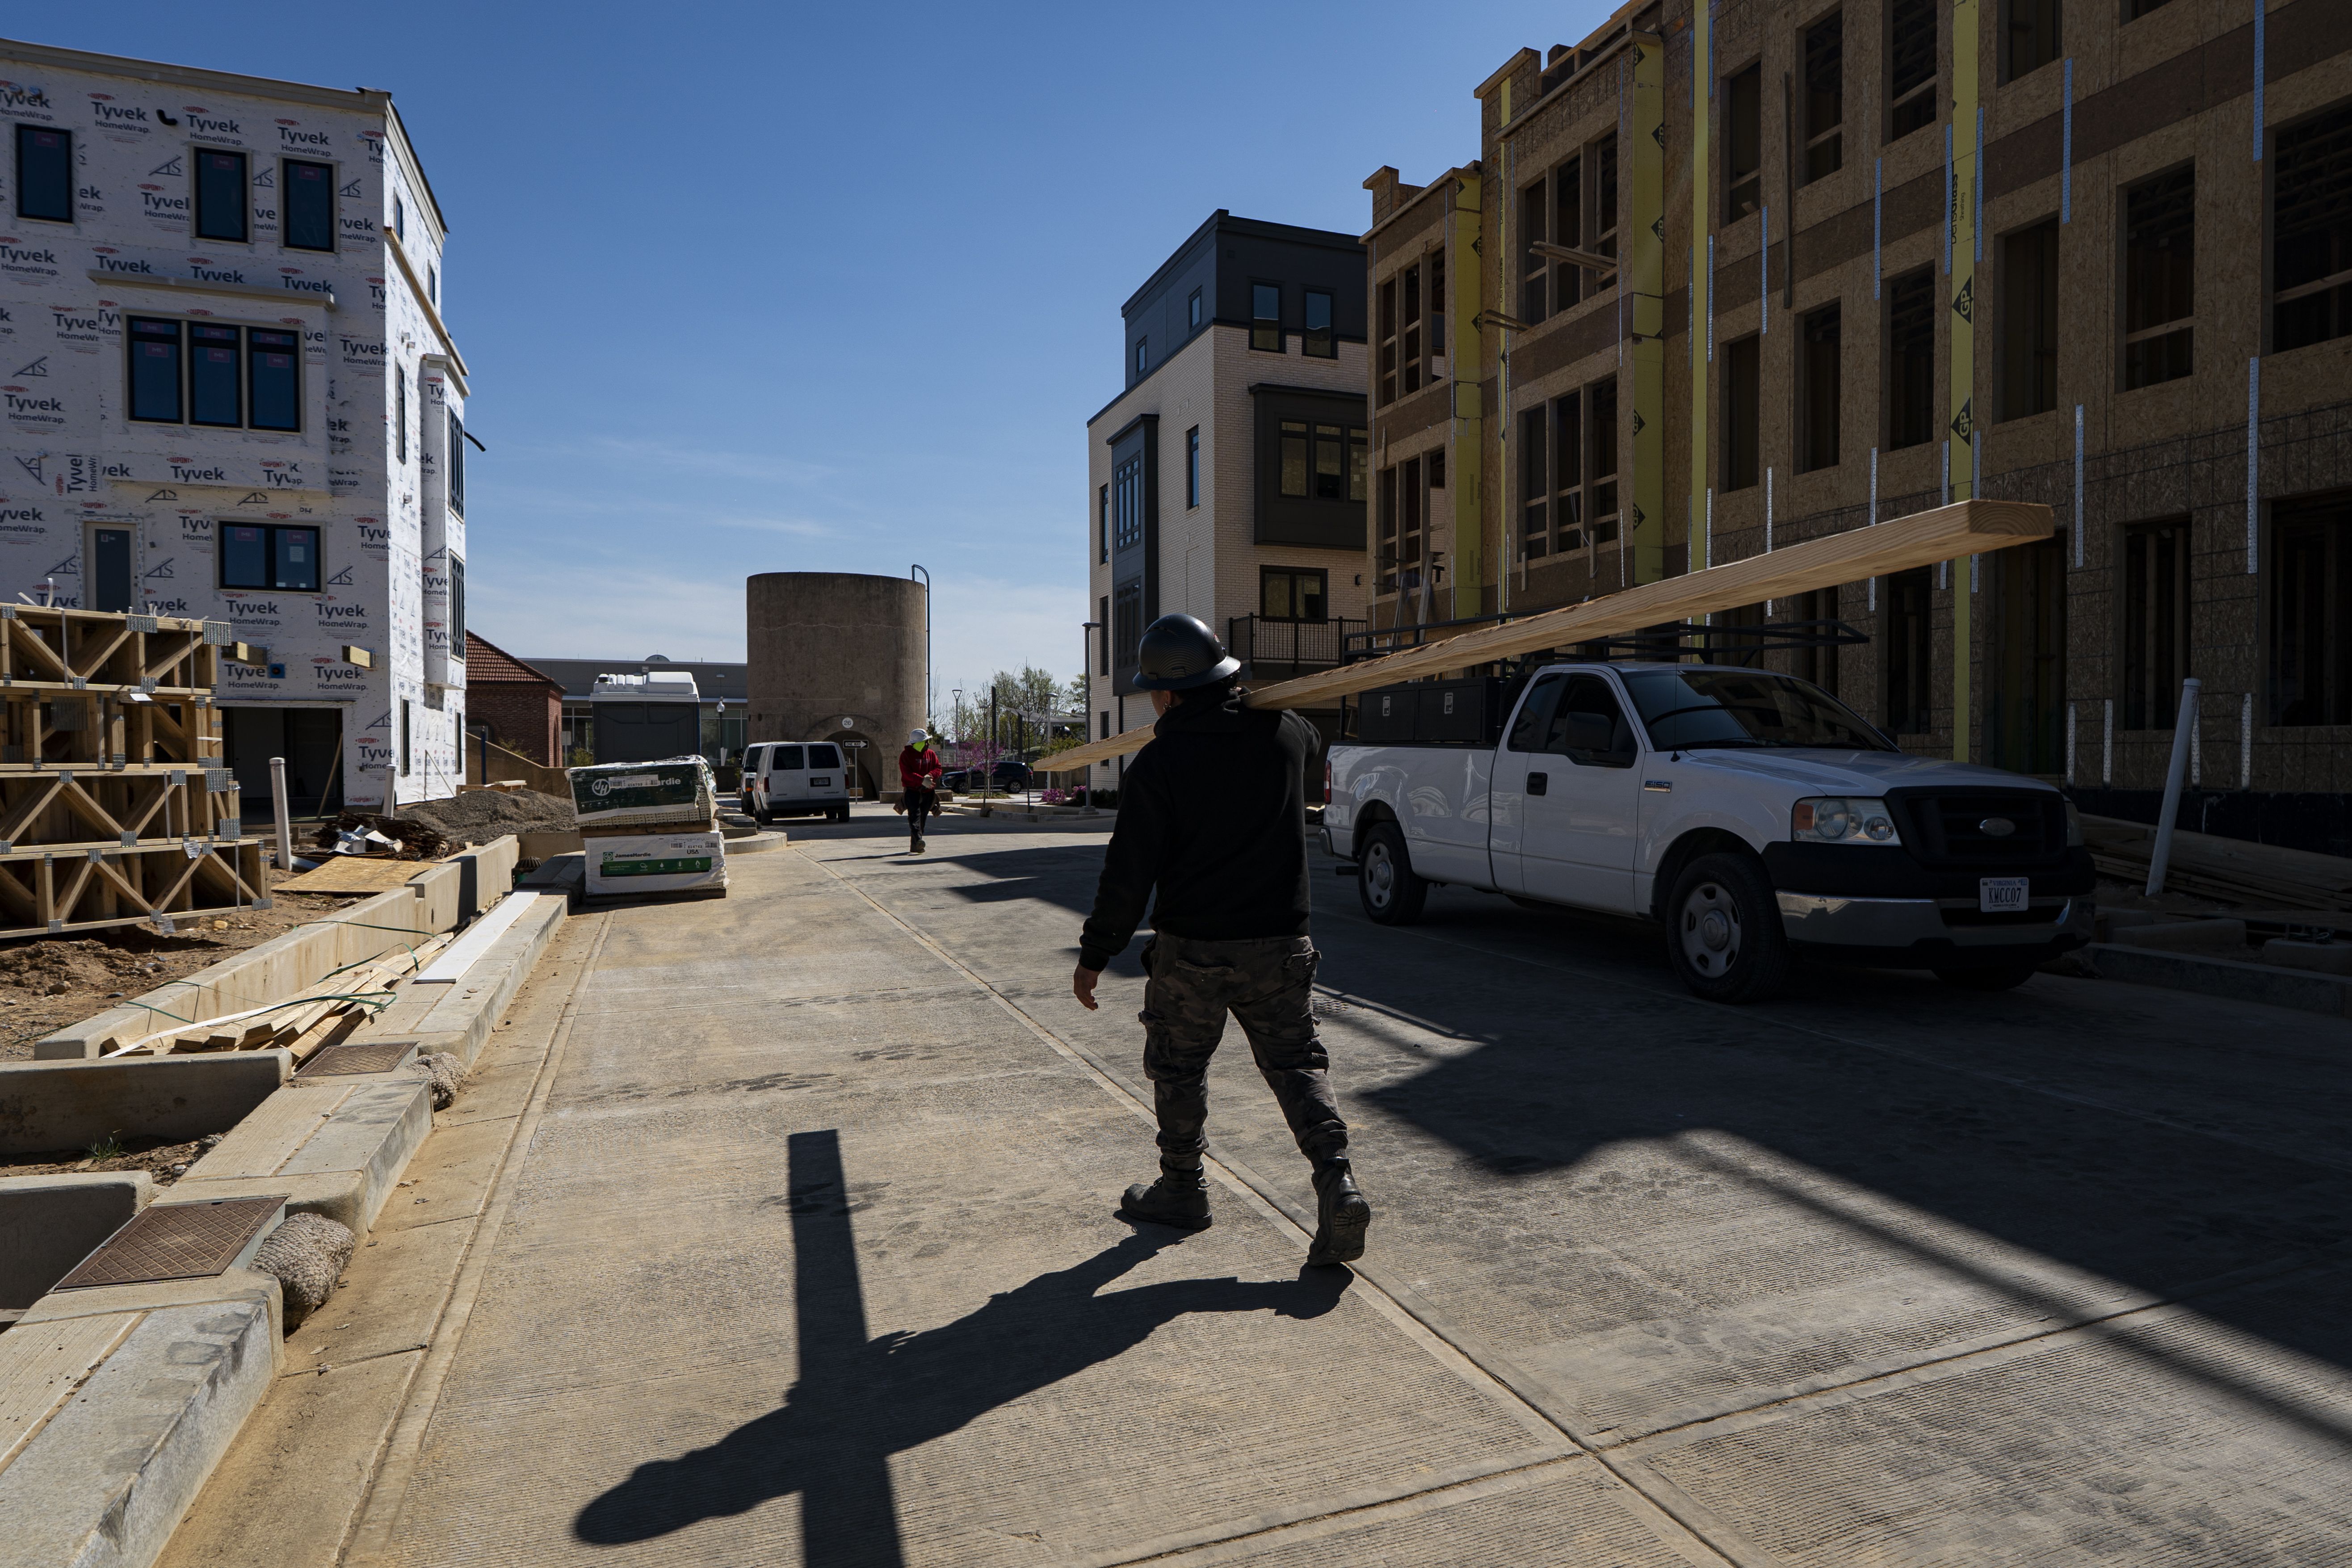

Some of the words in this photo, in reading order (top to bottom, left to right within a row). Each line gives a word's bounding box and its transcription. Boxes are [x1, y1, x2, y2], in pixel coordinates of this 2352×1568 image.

[89, 92, 113, 101] DUPONT
[91, 101, 147, 121] Tyvek
[95, 120, 148, 134] HomeWrap
[186, 114, 240, 134] Tyvek
[190, 132, 242, 146] HomeWrap
[277, 127, 329, 145] Tyvek
[281, 144, 331, 157] HomeWrap
[2, 264, 57, 276] HomeWrap
[96, 255, 150, 273] Tyvek
[191, 266, 243, 284] Tyvek
[281, 276, 332, 293] Tyvek
[1960, 290, 1970, 315] GP
[4, 394, 62, 412] Tyvek
[8, 413, 63, 425] HomeWrap
[1959, 411, 1970, 437] GP
[170, 466, 224, 483] Tyvek
[226, 600, 278, 616] Tyvek
[315, 603, 365, 619] Tyvek
[229, 618, 280, 626] HomeWrap
[319, 620, 367, 629] HomeWrap
[228, 681, 279, 690] HomeWrap
[318, 683, 366, 692] HomeWrap
